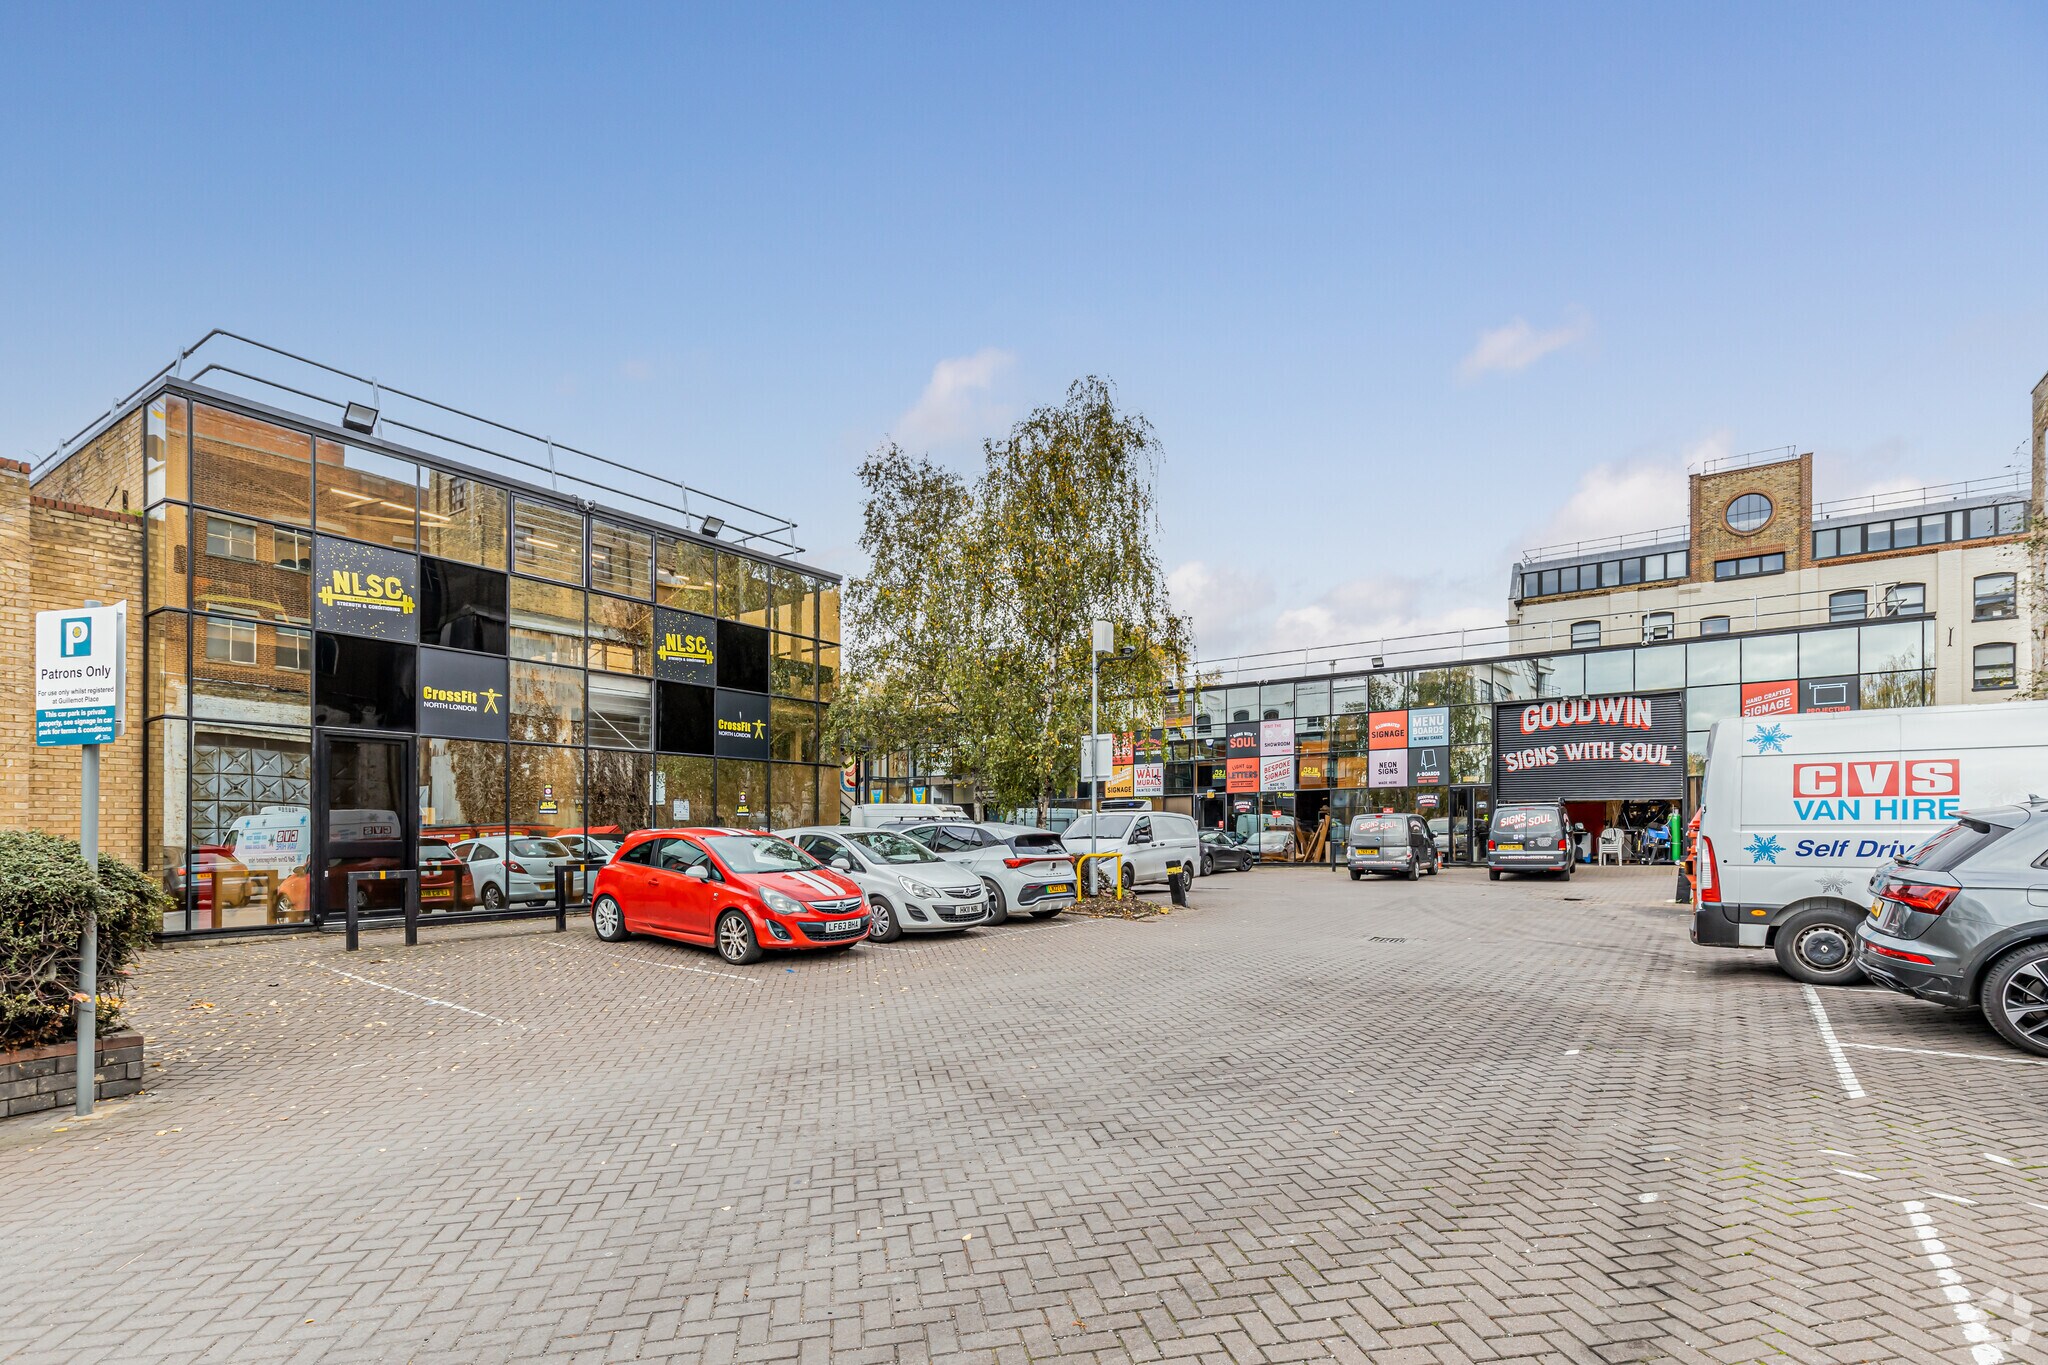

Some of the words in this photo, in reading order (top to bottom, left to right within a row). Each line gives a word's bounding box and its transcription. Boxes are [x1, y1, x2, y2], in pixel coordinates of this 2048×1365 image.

[333, 570, 402, 600] NLSC
[665, 633, 706, 654] NLSC
[41, 668, 82, 680] Patrons
[86, 665, 111, 679] Only
[87, 687, 114, 695] registered
[423, 686, 477, 704] CrossFit
[1745, 696, 1762, 704] HAND
[1763, 688, 1791, 699] CRAFTED
[423, 701, 448, 709] NORTH
[449, 703, 477, 712] LONDON
[1744, 698, 1791, 717] SIGNAGE
[67, 710, 80, 718] park
[86, 709, 106, 717] private
[1520, 697, 1652, 735] GOODWIN
[38, 720, 63, 728] property,
[74, 718, 96, 726] signage
[718, 719, 751, 732] CrossFit
[1412, 716, 1444, 727] MENU
[1371, 730, 1405, 738] SIGNAGE
[1412, 726, 1444, 735] BOARDS
[1230, 737, 1257, 748] SOUL
[1505, 746, 1559, 772] SIGNS
[1563, 742, 1614, 761] WITH
[1619, 743, 1671, 766] SOUL
[1264, 760, 1291, 774] BESPOKE
[1136, 769, 1161, 779] WALL
[1228, 771, 1258, 779] LETTERS
[1264, 768, 1291, 781] SIGNAGE
[1796, 761, 1955, 796] CVS
[1793, 800, 1860, 820] VAN
[1875, 798, 1960, 820] HIRE
[1360, 821, 1379, 831] SIGNS
[1380, 821, 1398, 830] SOUL
[1500, 813, 1526, 828] SIGNS
[1528, 814, 1552, 826] SOUL
[1795, 840, 1850, 858] Self
[1856, 840, 1916, 858] Driv
[828, 922, 847, 931] LF63
[848, 920, 859, 930] BHA
